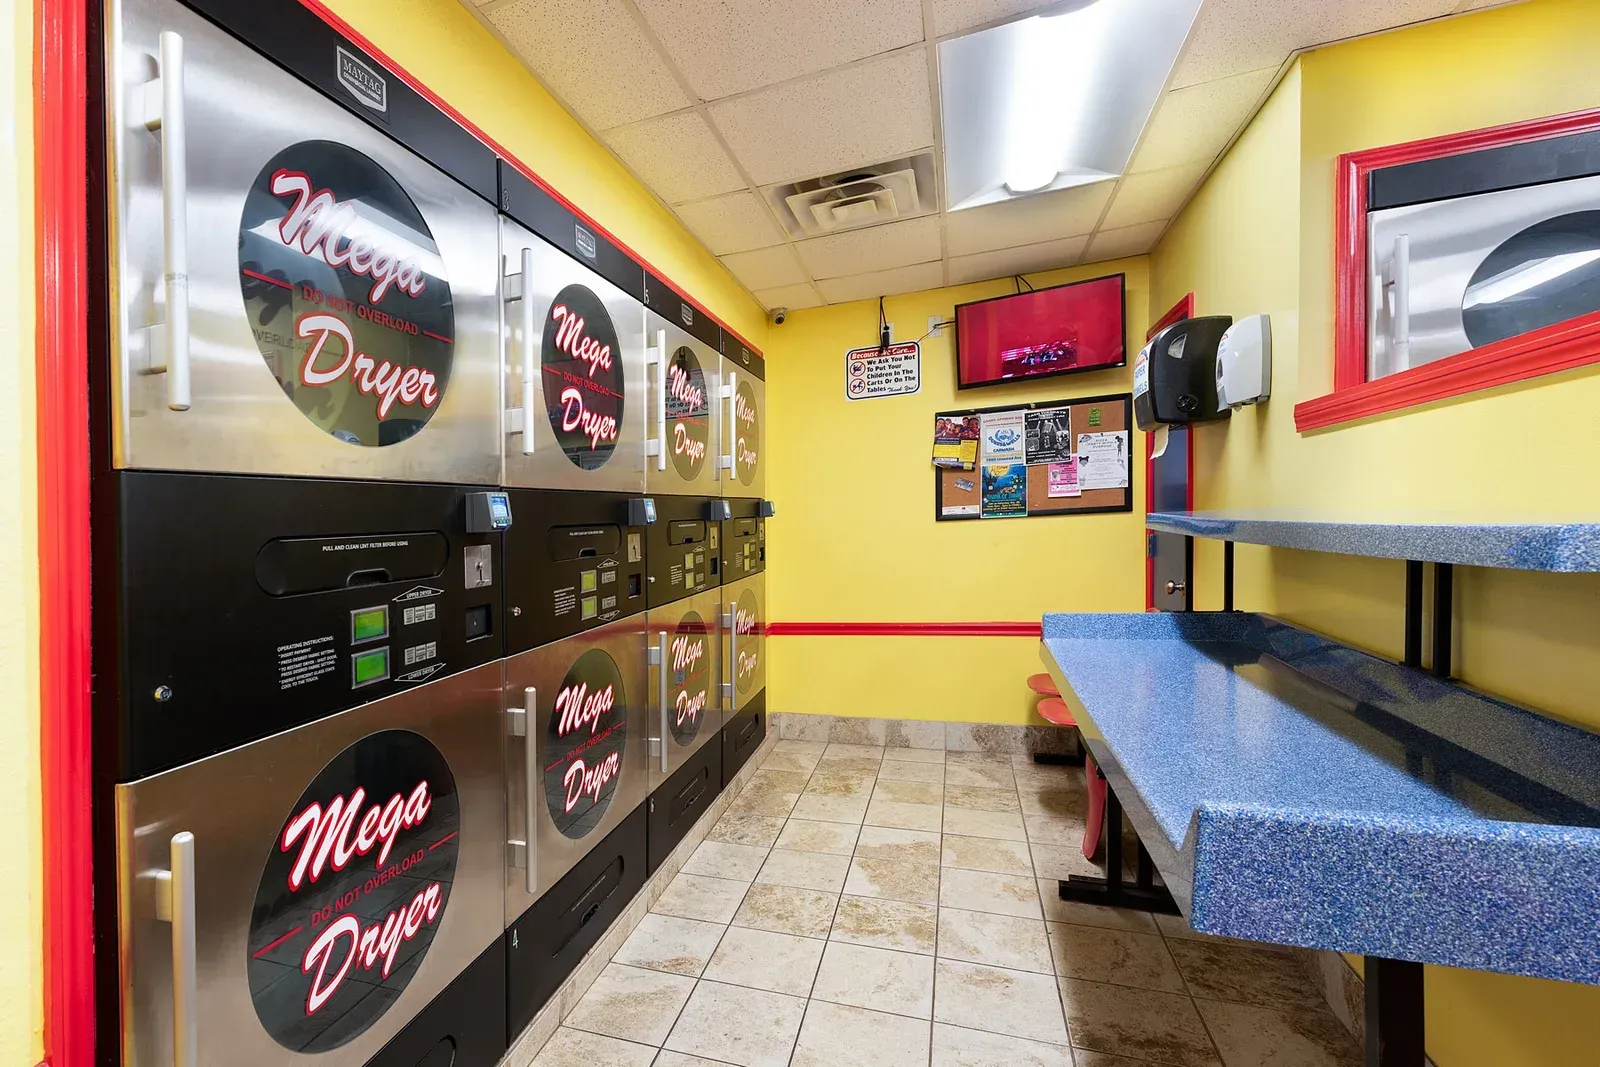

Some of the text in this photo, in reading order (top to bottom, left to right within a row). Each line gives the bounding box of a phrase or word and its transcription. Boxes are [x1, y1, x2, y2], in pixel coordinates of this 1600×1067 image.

[343, 59, 381, 94] MAYTAG
[270, 168, 426, 304] Mega
[303, 285, 419, 337] DO NOT OVERLOAD
[552, 303, 612, 379] Mega
[851, 350, 878, 360] Because
[296, 312, 438, 420] Dryer
[564, 371, 610, 396] DO NOT OVERLOAD
[867, 372, 892, 380] Children
[867, 379, 883, 387] Carts
[670, 364, 702, 414] Mega
[560, 386, 617, 451] Dryer
[736, 393, 755, 431] Mega
[674, 423, 704, 468] Dryer
[738, 437, 757, 470] Dryer
[736, 608, 755, 639] Mega
[277, 641, 302, 652] OPERATING
[672, 635, 703, 673] Mega
[738, 651, 757, 679] Dryer
[556, 681, 615, 738] Mega
[676, 690, 706, 727] Dryer
[566, 749, 574, 760] DO
[586, 727, 612, 750] OVERLOAD
[564, 751, 619, 814] Dryer
[281, 780, 432, 892] Mega
[311, 848, 424, 928] DO NOT OVERLOAD
[301, 881, 443, 1016] Dryer
[512, 928, 519, 949] 4
